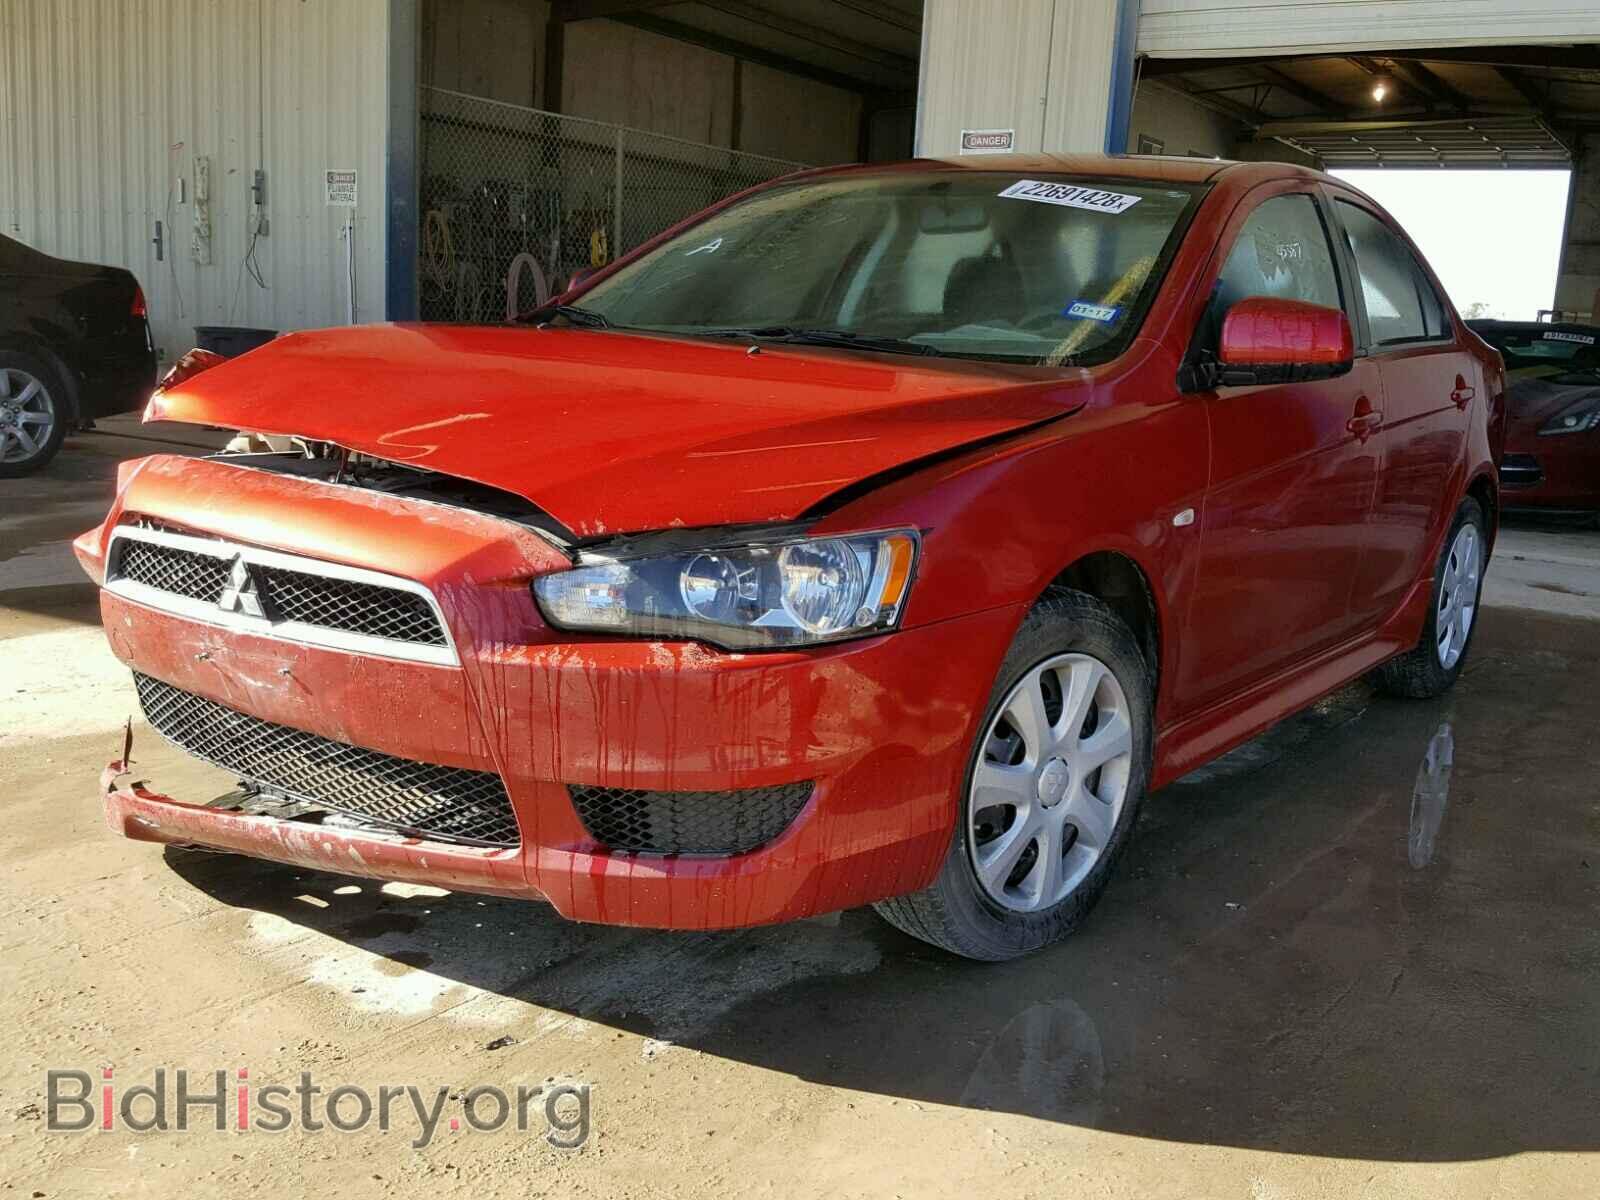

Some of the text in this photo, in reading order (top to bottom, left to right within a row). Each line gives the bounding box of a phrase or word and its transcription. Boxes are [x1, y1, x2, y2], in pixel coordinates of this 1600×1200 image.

[970, 135, 1007, 146] DANGER
[685, 238, 723, 256] A
[1071, 305, 1112, 318] 01-17
